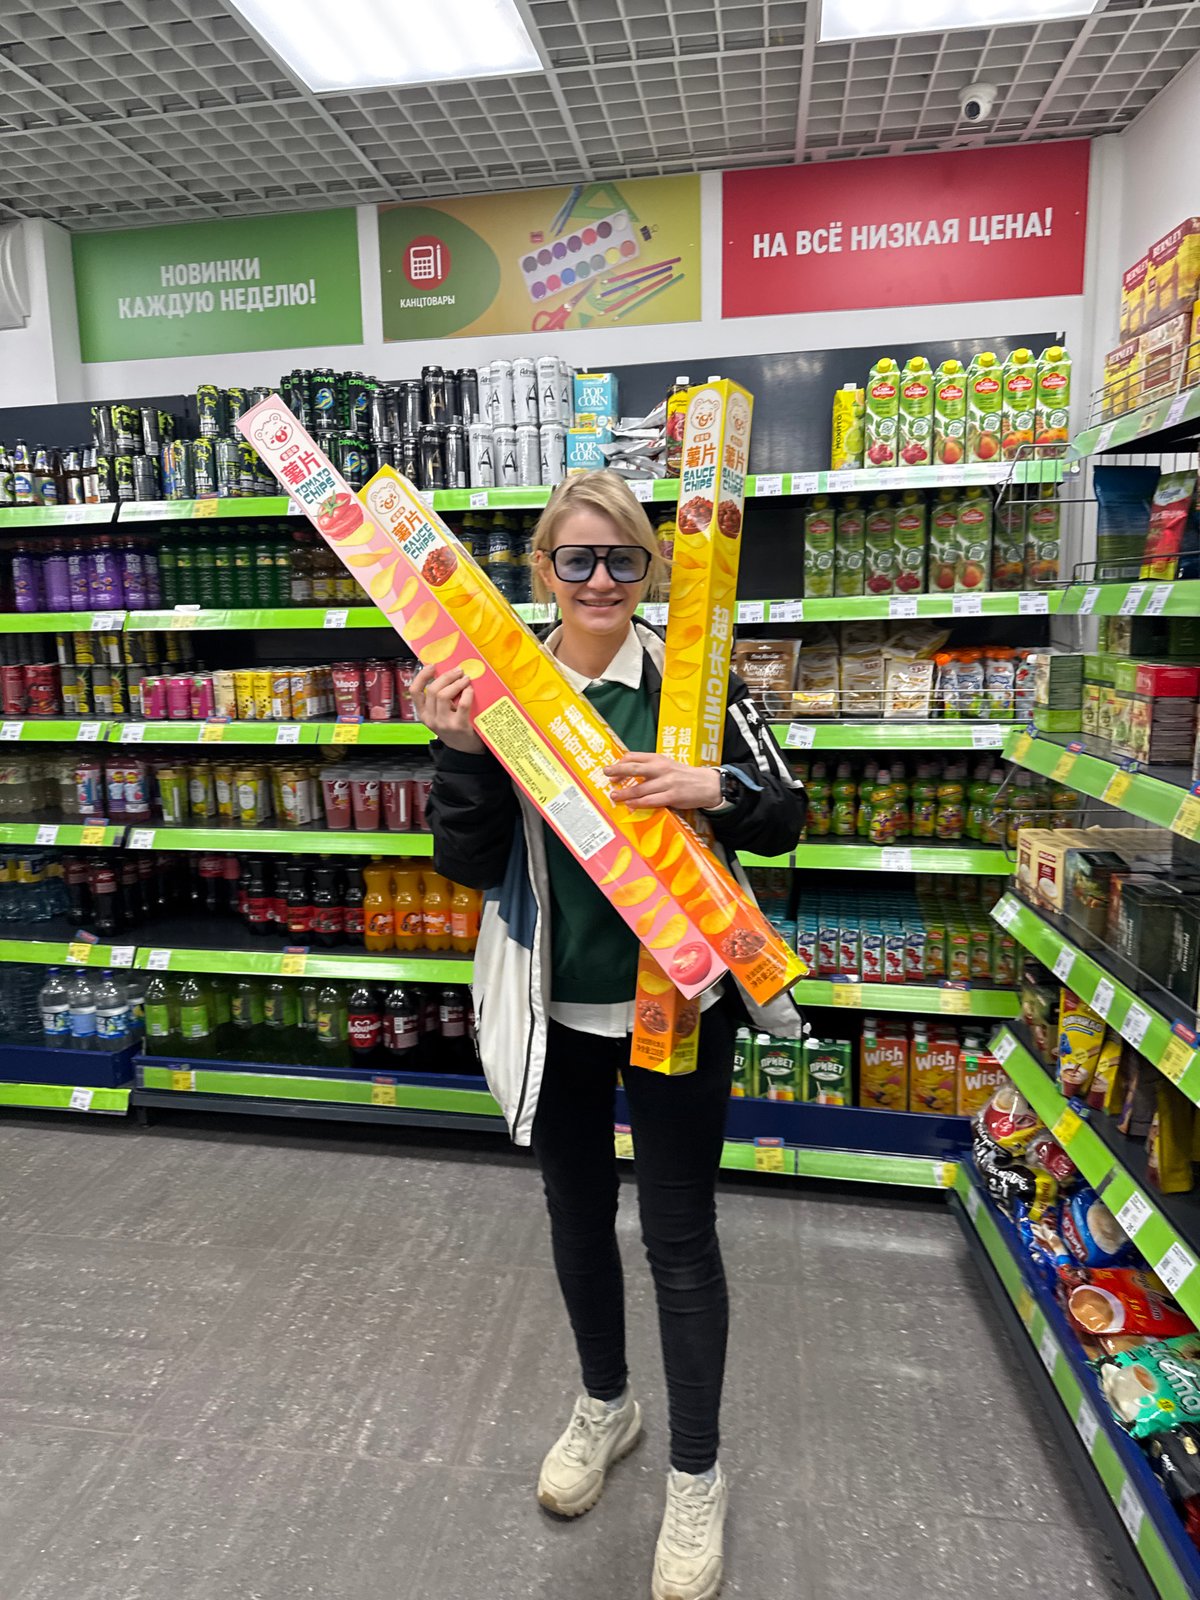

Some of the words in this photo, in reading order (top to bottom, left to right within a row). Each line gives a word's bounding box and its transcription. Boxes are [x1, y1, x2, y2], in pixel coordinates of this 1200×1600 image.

[752, 232, 787, 259] НА
[795, 222, 842, 256] ВСЁ
[850, 218, 960, 251] НИЗКАЯ
[968, 207, 1053, 246] ЦЕНА!
[160, 257, 261, 288] НОВИНКИ
[118, 290, 215, 319] КАЖДУЮ
[220, 279, 318, 313] НЕДЕЛЮ!
[400, 294, 456, 308] КАНЦТОВАРЫ
[578, 395, 609, 406] CORN
[583, 387, 604, 398] POP
[570, 451, 601, 461] CORN
[575, 442, 597, 453] POP
[686, 443, 716, 468] 薯片
[280, 450, 322, 485] 薯片
[683, 466, 716, 482] SAUCE
[295, 467, 332, 497] TOMATO
[302, 477, 336, 505] CHIPS
[684, 477, 713, 493] CHIPS
[391, 510, 424, 543] 薯片
[403, 522, 433, 554] SAUCE
[411, 532, 437, 560] CHIPS
[760, 1057, 795, 1069] ПРИВЕТ
[865, 1046, 904, 1067] Wish
[916, 1051, 956, 1071] Wish
[809, 1061, 844, 1075] ПРИВЕТ
[965, 1069, 1007, 1090] Wish
